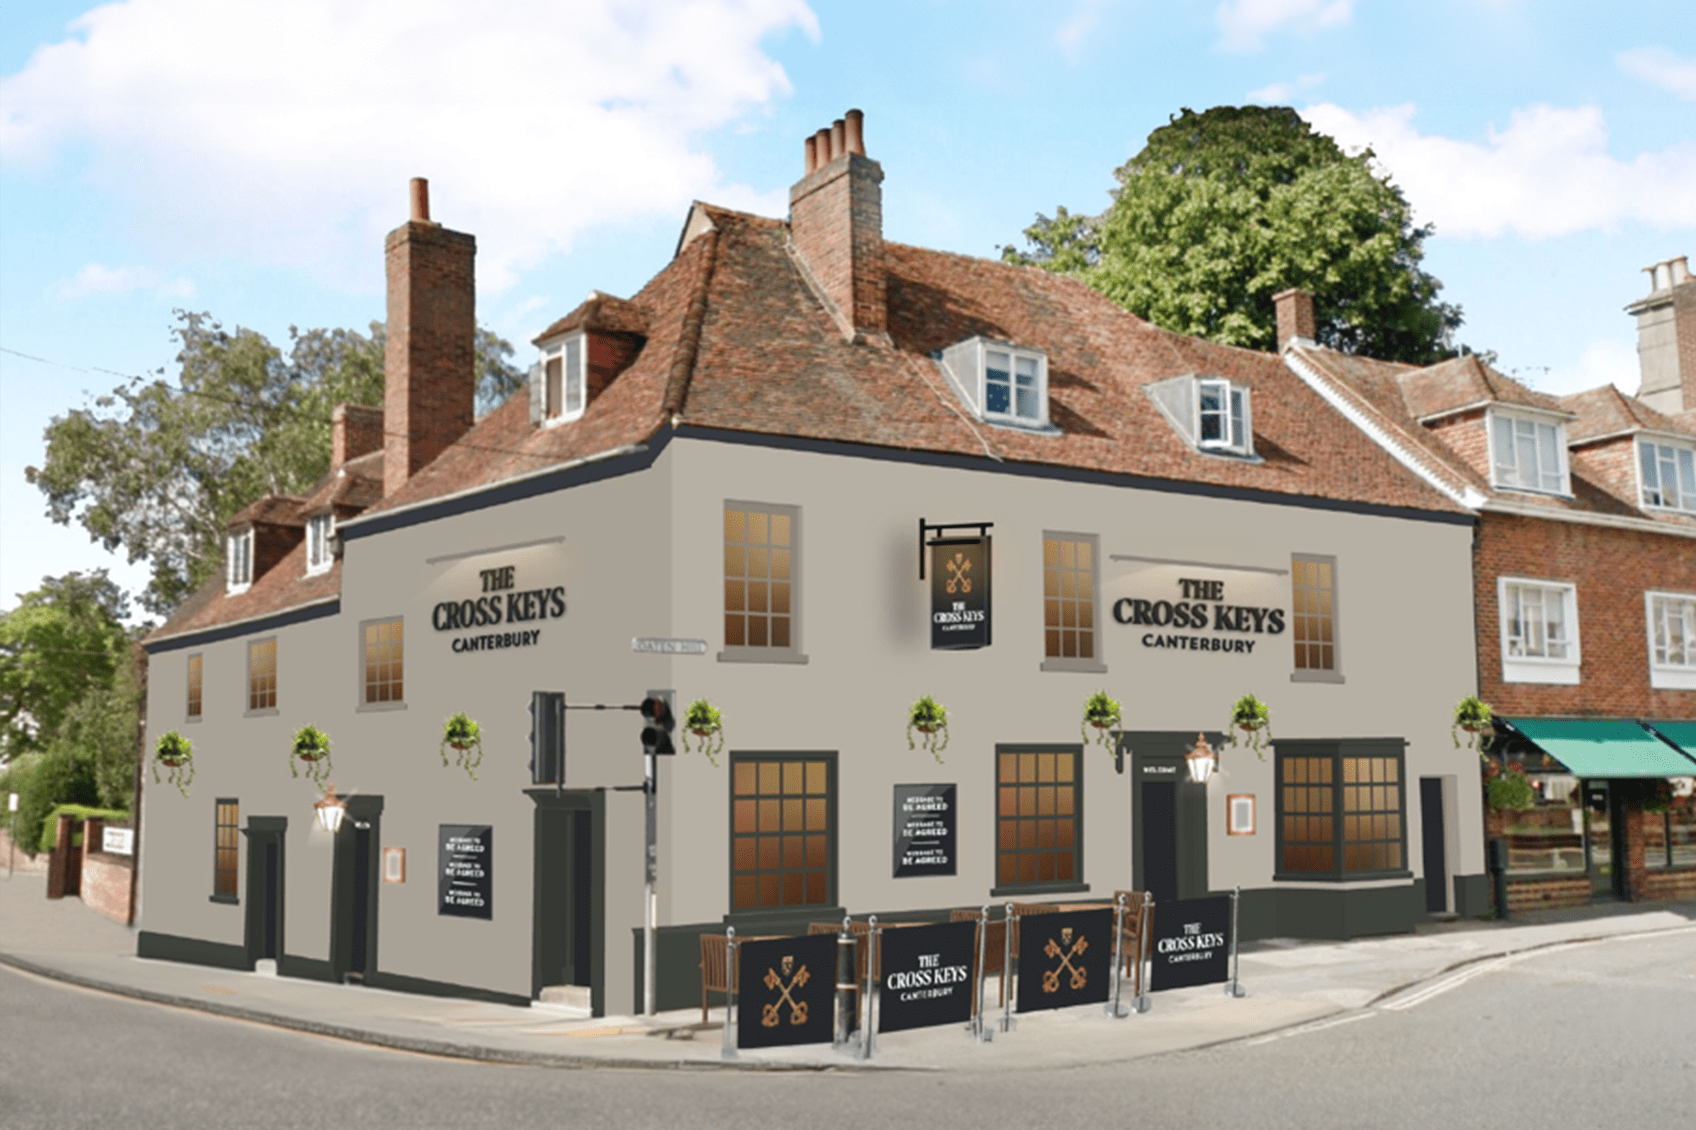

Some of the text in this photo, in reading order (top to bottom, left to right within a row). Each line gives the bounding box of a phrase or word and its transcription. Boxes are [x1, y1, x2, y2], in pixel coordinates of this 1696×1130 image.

[480, 566, 515, 592] THE
[1178, 578, 1224, 601] THE
[432, 586, 566, 632] CROSS KEYS
[934, 610, 984, 624] CROSS KEYS
[1113, 598, 1286, 634] CROSS KEYS
[452, 630, 540, 653] CANTERBURY
[1142, 634, 1256, 653] CANTERBURY
[1158, 932, 1224, 953] CROSS KEYS
[918, 954, 940, 968] THE
[888, 966, 968, 990] CROSS KEYS
[900, 987, 954, 1002] CANTERBURY
